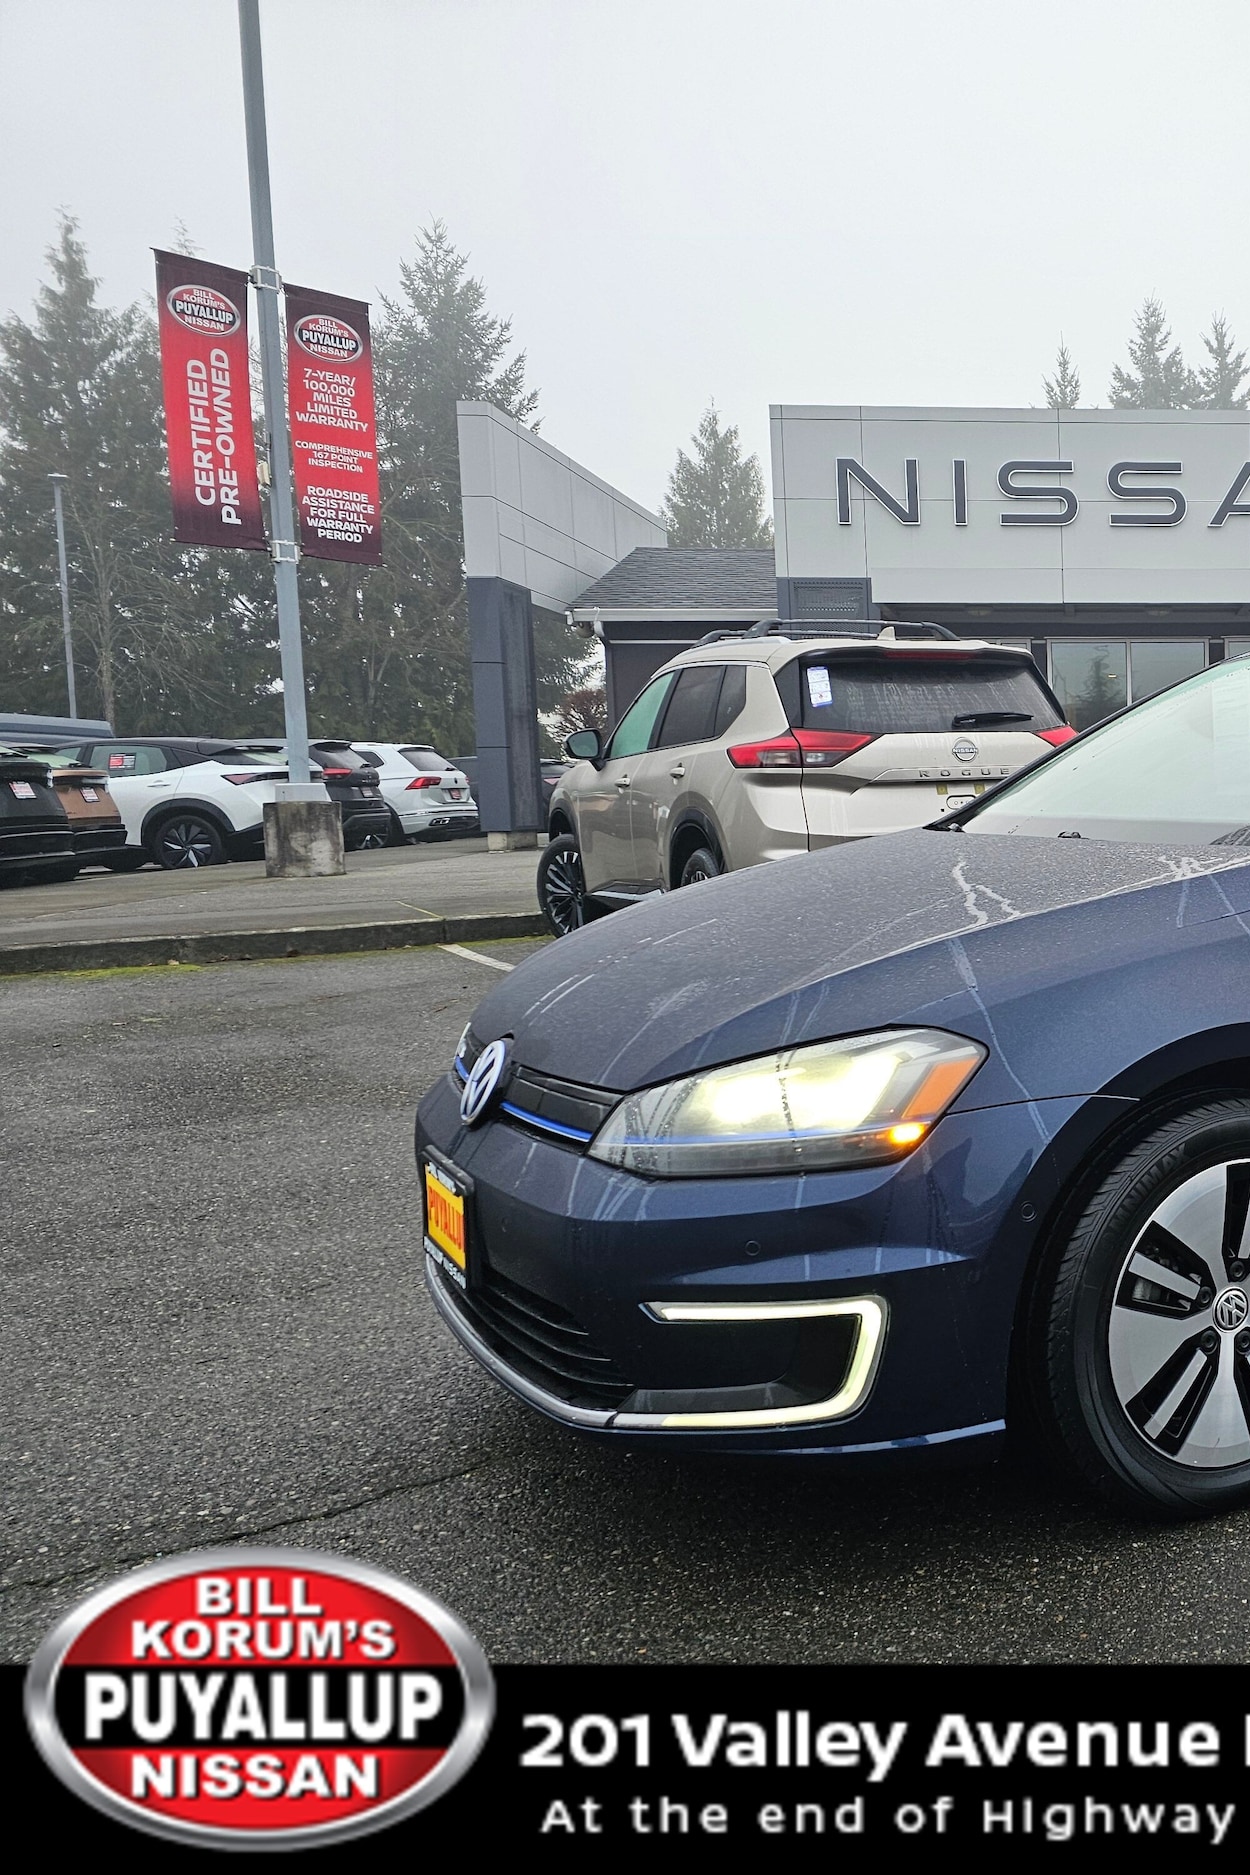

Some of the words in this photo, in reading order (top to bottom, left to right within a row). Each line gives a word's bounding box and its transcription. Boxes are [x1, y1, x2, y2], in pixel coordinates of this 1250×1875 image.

[183, 293, 226, 309] KORUM'S
[193, 289, 215, 300] BILL
[175, 300, 234, 324] PUYALLUP
[184, 315, 225, 331] NISSAN
[309, 323, 349, 338] KORUM'S
[319, 318, 338, 329] BILL
[302, 329, 356, 351] PUYALLUP
[309, 343, 348, 358] NISSAN
[303, 367, 356, 387] 7-YEAR/
[302, 379, 356, 397] 100,000
[313, 391, 352, 408] MILES
[306, 401, 358, 420] LIMITED
[296, 411, 369, 433] WARRANTY
[186, 359, 216, 506] CERTIFIED
[210, 348, 242, 525] PRE-OWNED
[295, 440, 373, 460] COMPREHENSIVE
[313, 450, 330, 460] 167
[331, 453, 358, 464] POINT
[308, 457, 363, 473] INSPECTION
[307, 485, 369, 503] ROADSIDE
[302, 495, 375, 514] ASSISTANCE
[310, 506, 337, 519] FOR
[339, 510, 367, 524] FULL
[306, 516, 373, 535] WARRANTY
[317, 528, 363, 543] PERIOD
[919, 767, 1010, 778] ROGUE
